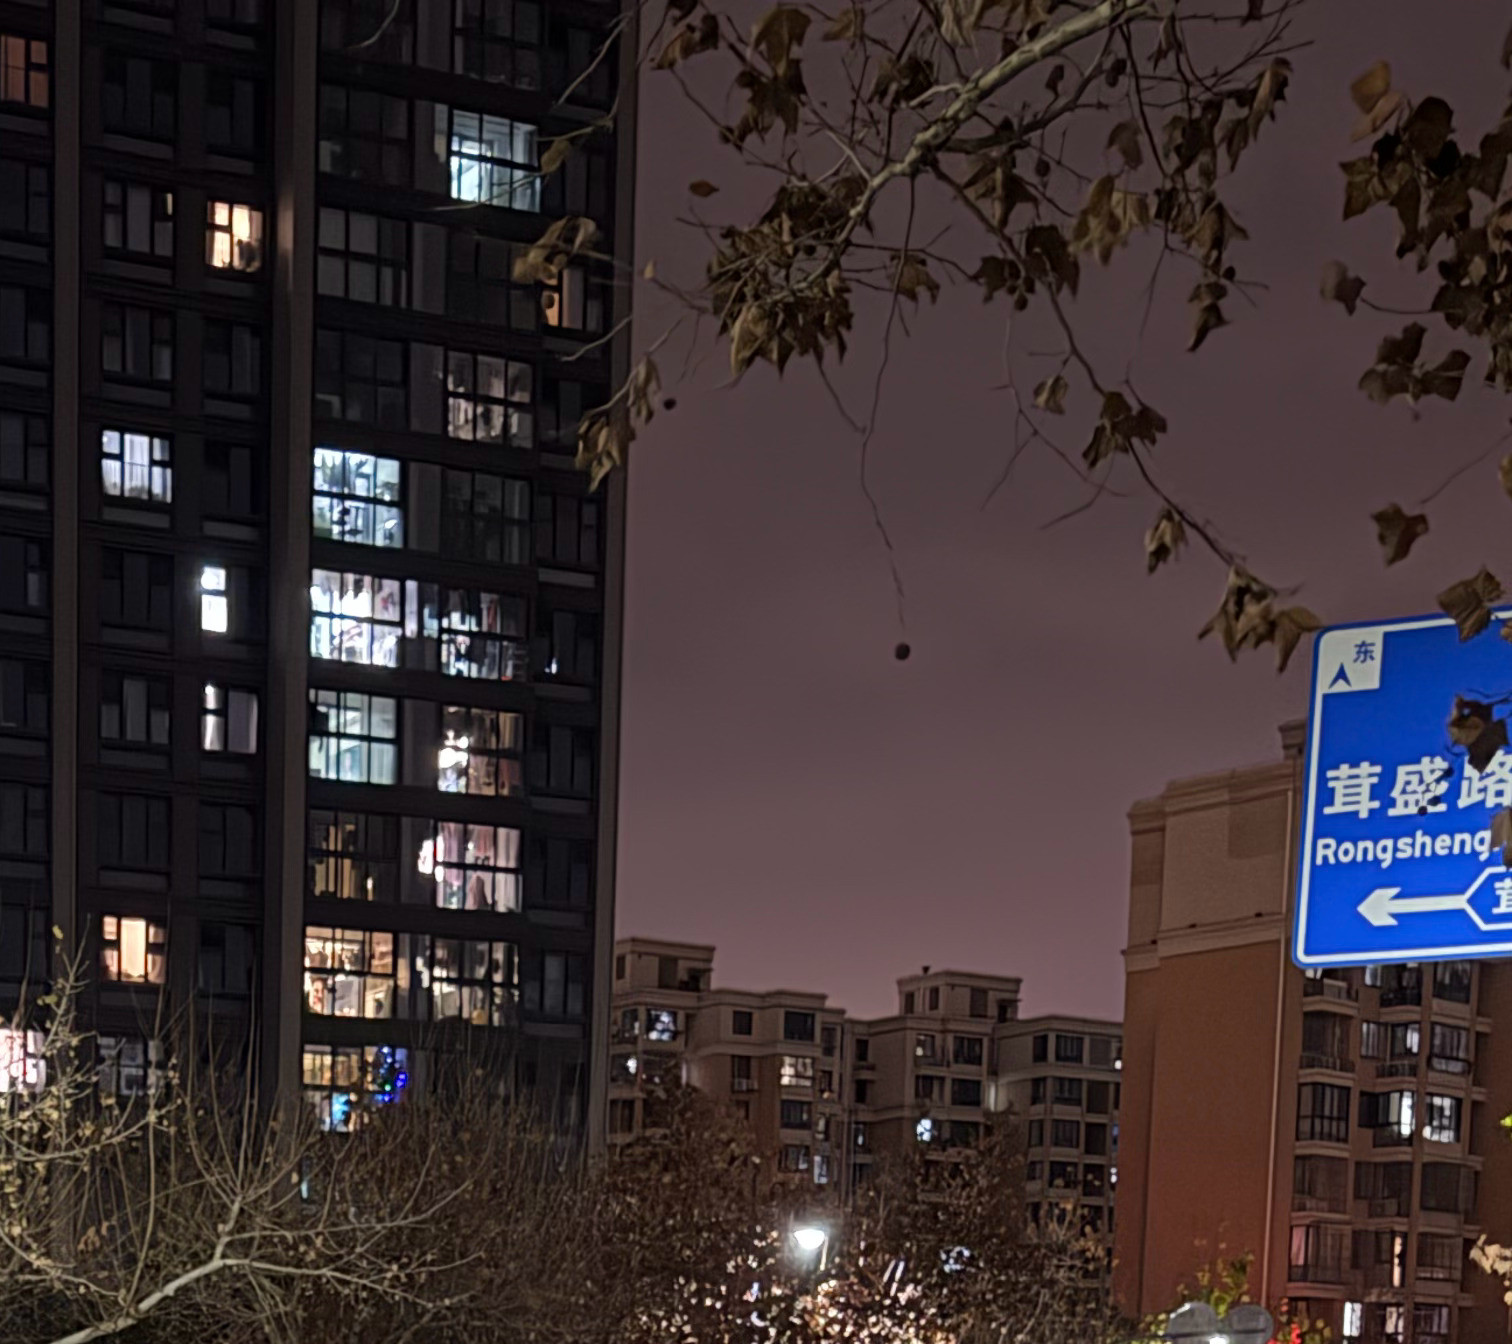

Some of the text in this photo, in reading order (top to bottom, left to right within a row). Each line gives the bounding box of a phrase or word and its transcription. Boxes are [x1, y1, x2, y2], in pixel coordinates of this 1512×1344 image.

[1352, 639, 1376, 663] 东
[1323, 749, 1512, 818] 茸盛路
[1315, 829, 1492, 869] Rongsheng
